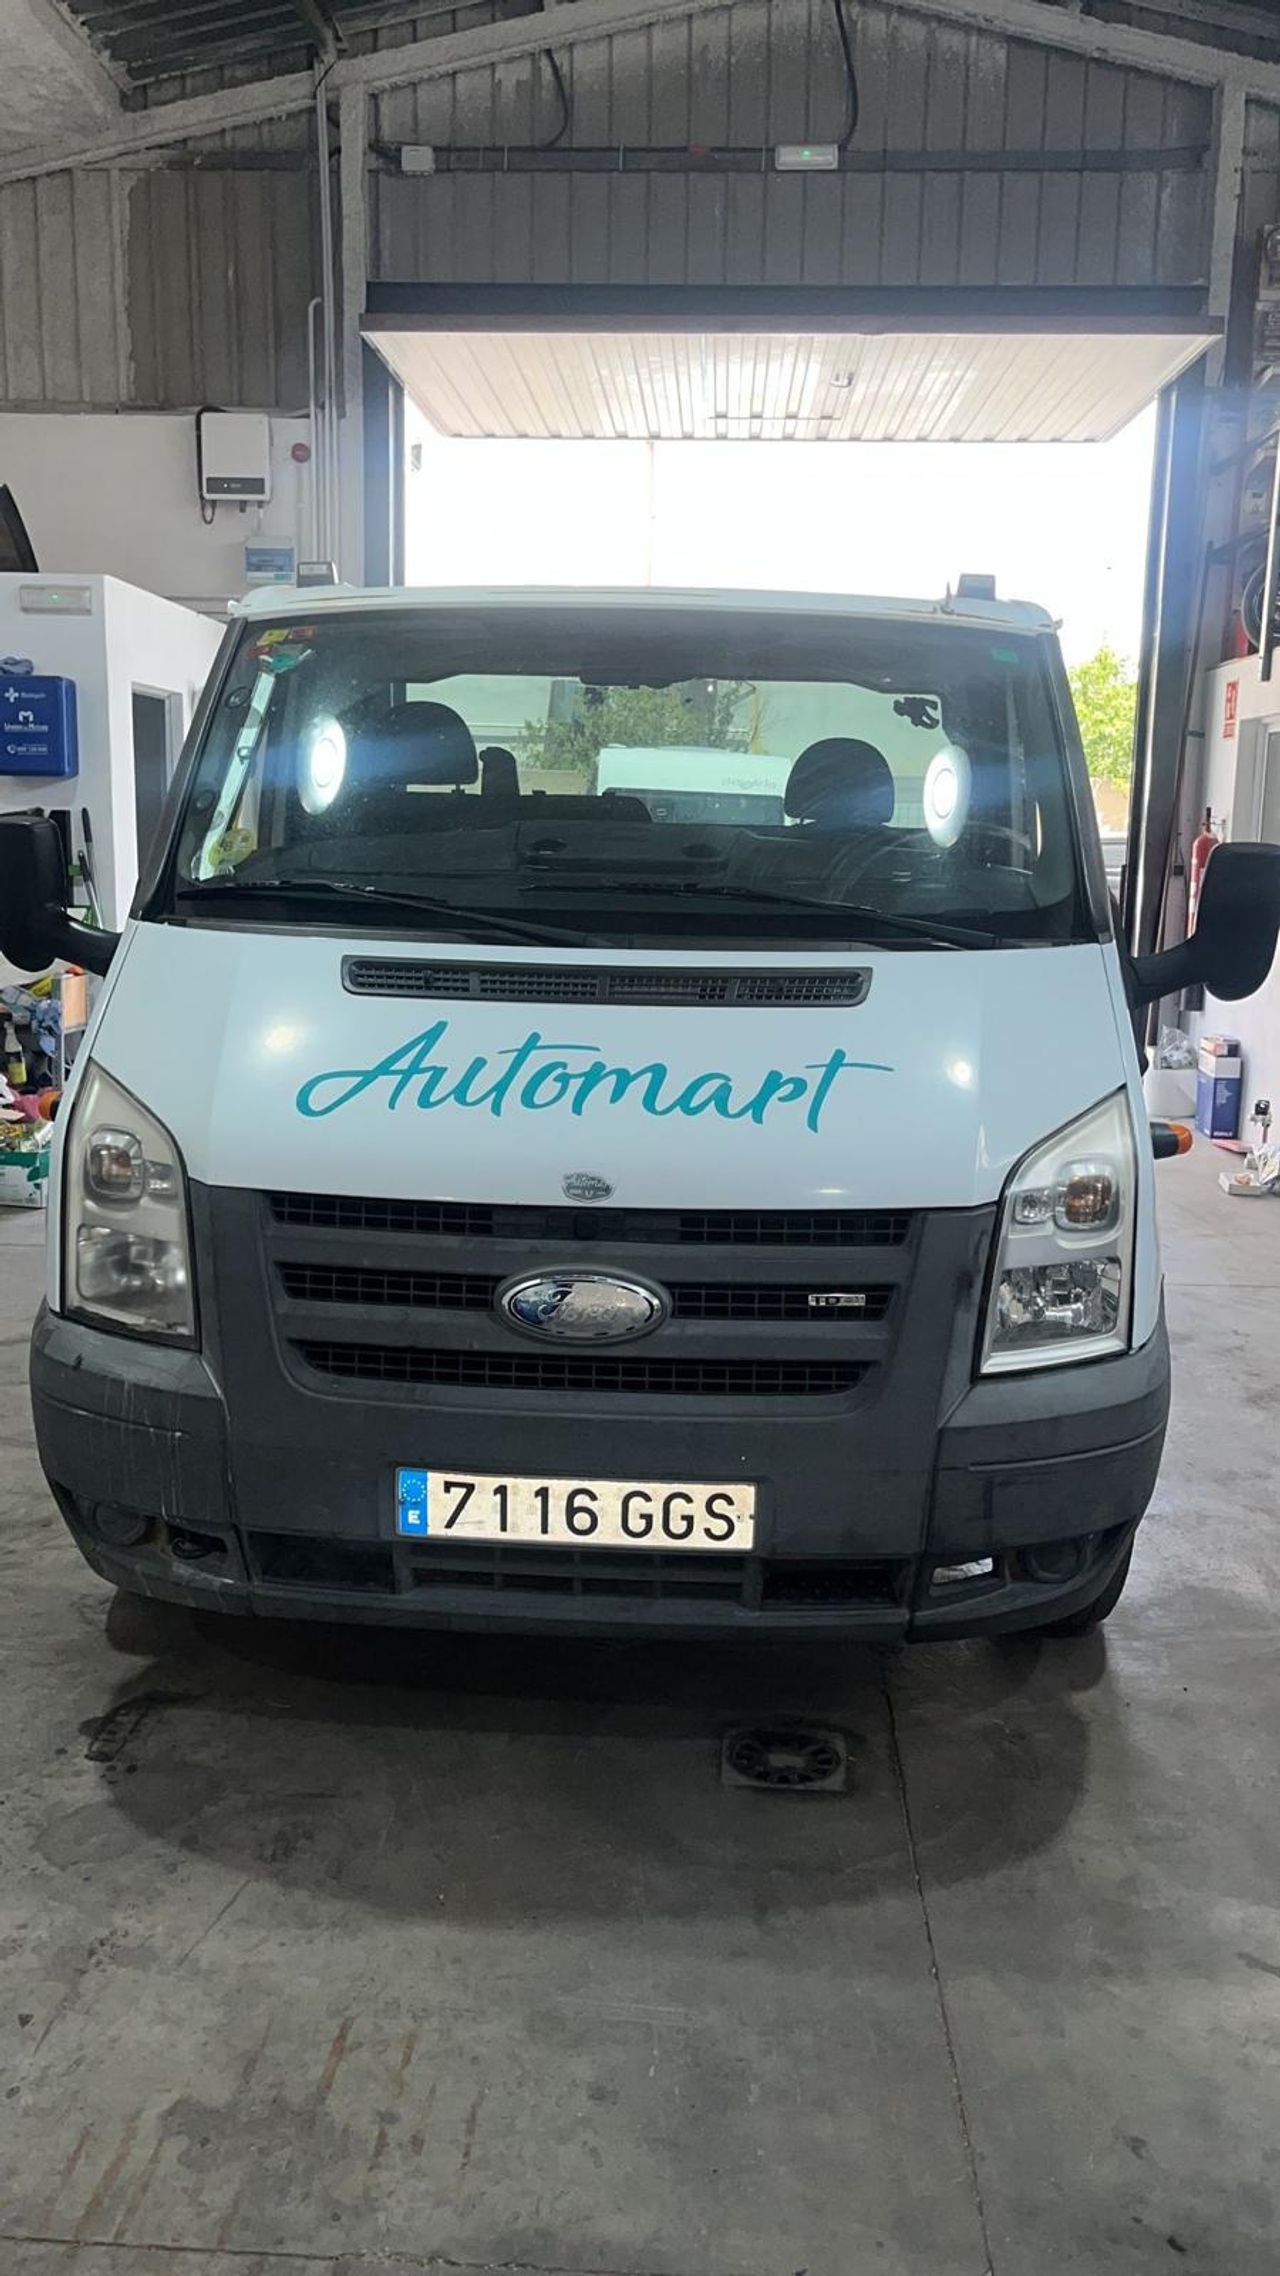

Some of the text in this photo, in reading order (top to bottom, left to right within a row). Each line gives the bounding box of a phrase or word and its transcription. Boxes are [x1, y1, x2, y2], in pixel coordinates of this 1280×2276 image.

[296, 1020, 894, 1133] Automart
[407, 1510, 421, 1525] E
[443, 1480, 736, 1542] 7116 GGS
